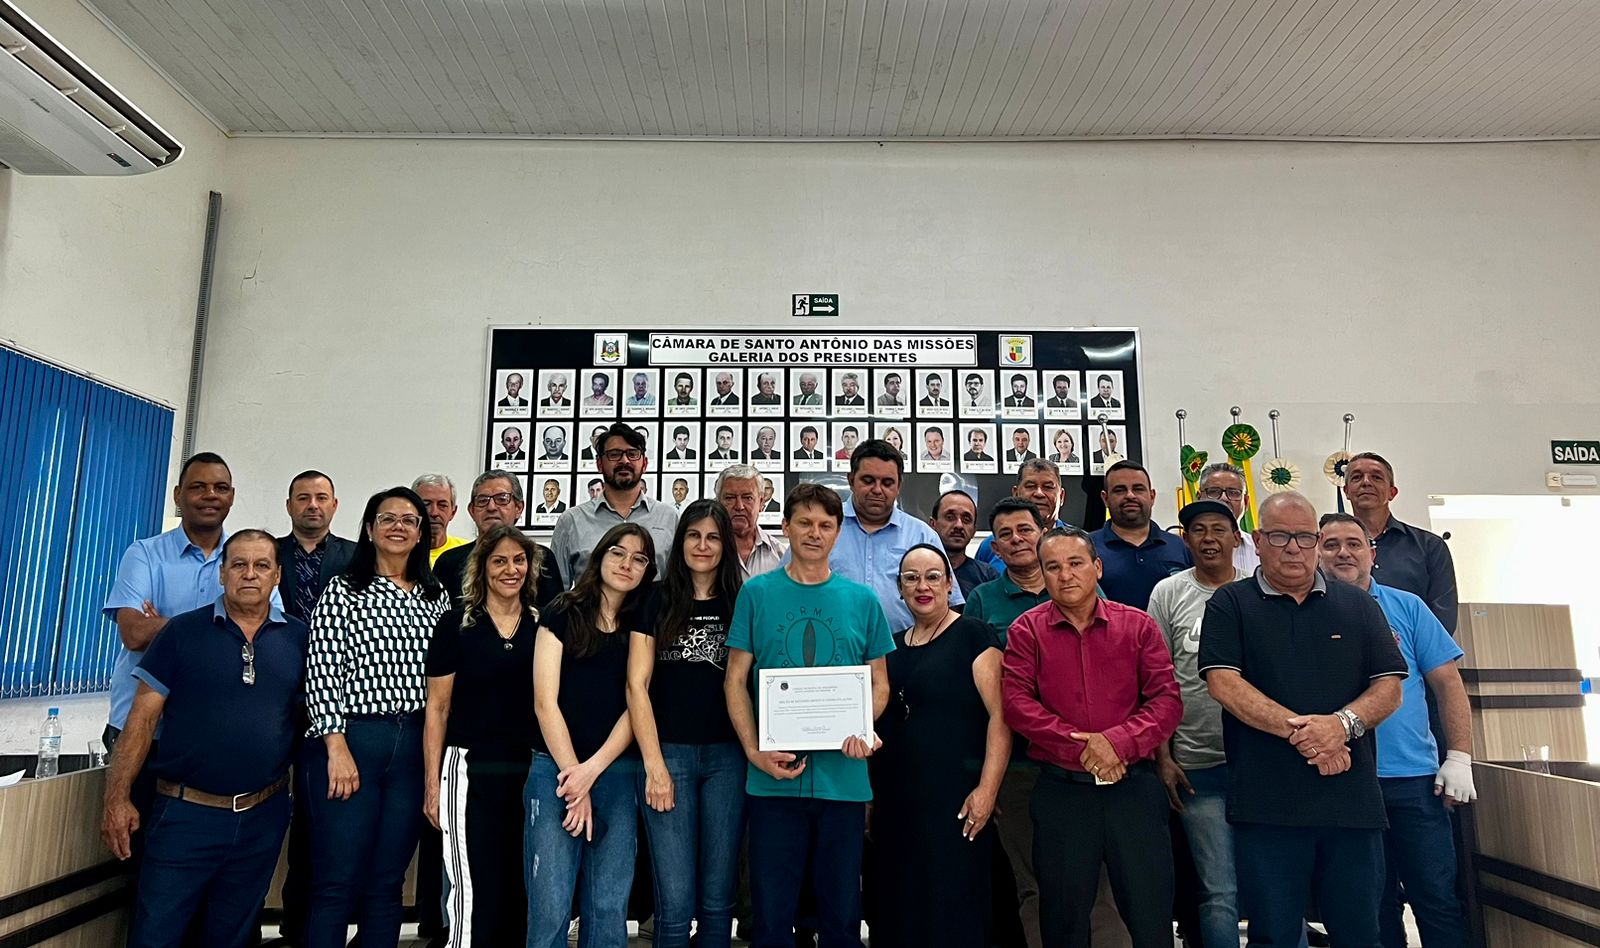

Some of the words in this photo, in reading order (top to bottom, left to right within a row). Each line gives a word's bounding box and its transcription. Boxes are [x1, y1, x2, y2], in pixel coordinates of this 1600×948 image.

[813, 296, 833, 304] SAÍDA
[652, 336, 715, 349] CÂMARA
[720, 339, 740, 349] DE
[745, 339, 795, 349] SANTO
[800, 337, 868, 350] ANTÔNIO
[873, 339, 902, 350] DAS
[908, 337, 974, 350] MISSÕES
[708, 352, 774, 362] GALERIA
[778, 352, 809, 363] DOS
[814, 352, 917, 363] PRESIDENTES
[1554, 442, 1600, 461] SAÍDA
